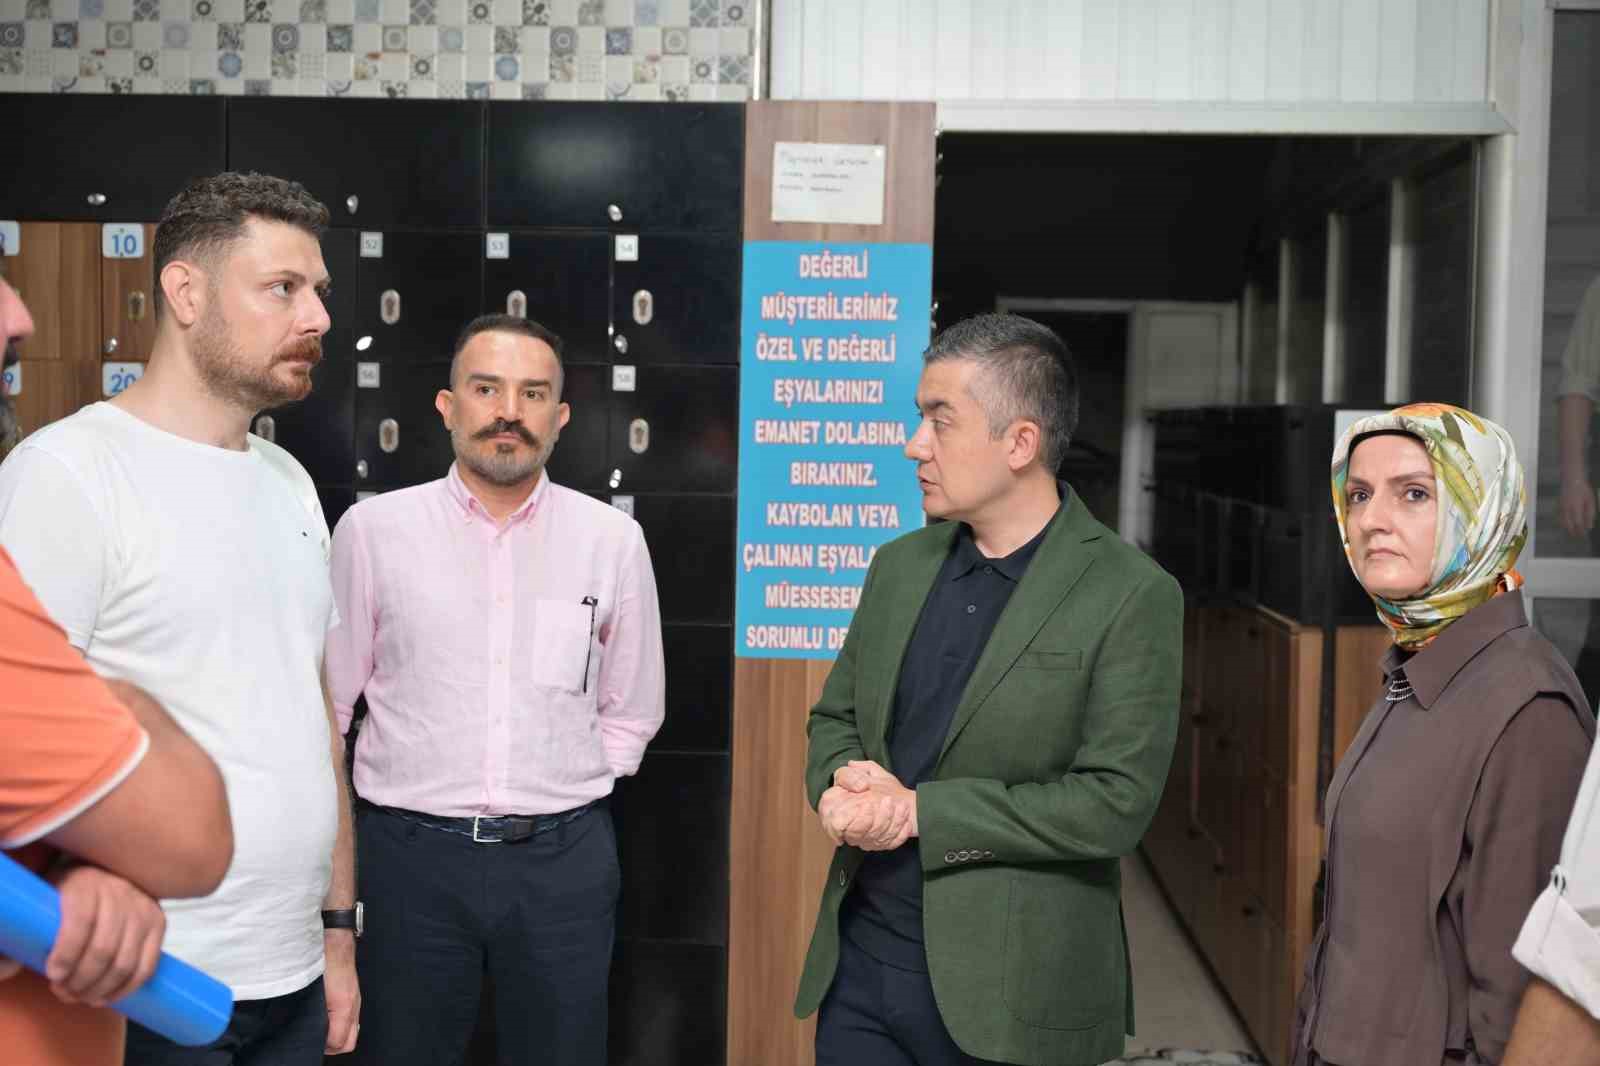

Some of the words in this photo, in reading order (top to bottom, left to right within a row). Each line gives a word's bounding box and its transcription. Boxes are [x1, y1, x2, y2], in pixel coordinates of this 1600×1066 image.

[112, 234, 137, 254] 10
[799, 250, 868, 278] DEĞERLİ
[761, 292, 898, 326] MÜŞTERİLERİMİZ
[756, 333, 797, 361] ÖZEL
[802, 338, 823, 361] VE
[827, 334, 896, 363] DEĞERLİ
[773, 379, 883, 408] EŞYALARINIZI
[755, 420, 820, 443] EMANET
[825, 422, 906, 445] DOLABINA
[790, 462, 877, 487] BIRAKINIZ.
[767, 503, 853, 527] KAYBOLAN
[858, 505, 899, 528] VEYA
[743, 544, 813, 572] ÇALINAN
[746, 626, 823, 648] SORUMLU
